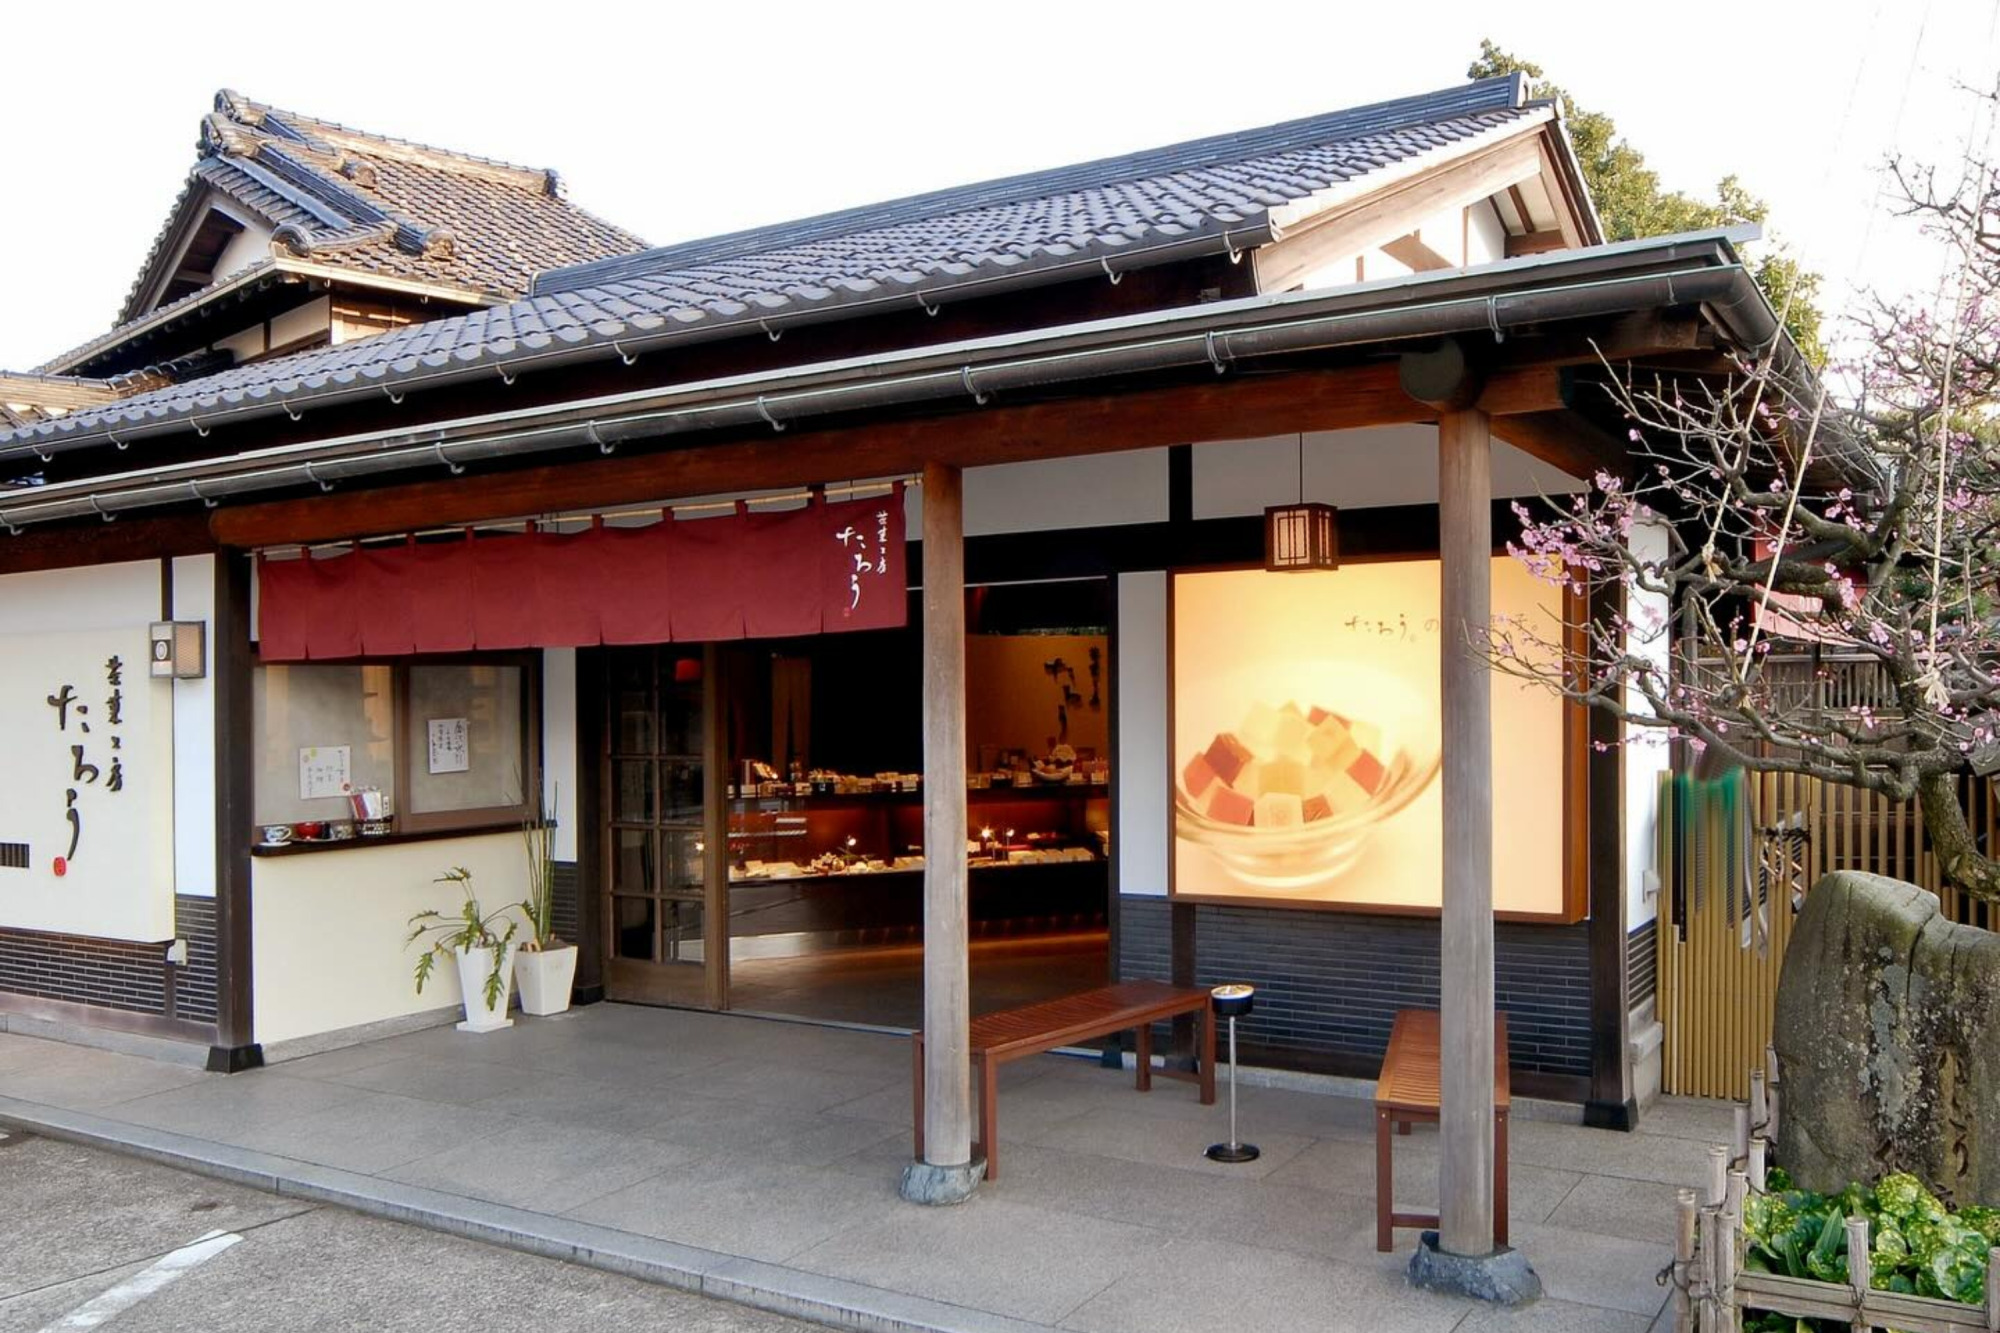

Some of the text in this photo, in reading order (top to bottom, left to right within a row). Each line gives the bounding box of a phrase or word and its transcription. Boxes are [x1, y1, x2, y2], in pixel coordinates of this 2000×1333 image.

[835, 526, 873, 610] たろう
[47, 684, 99, 861] たろう
